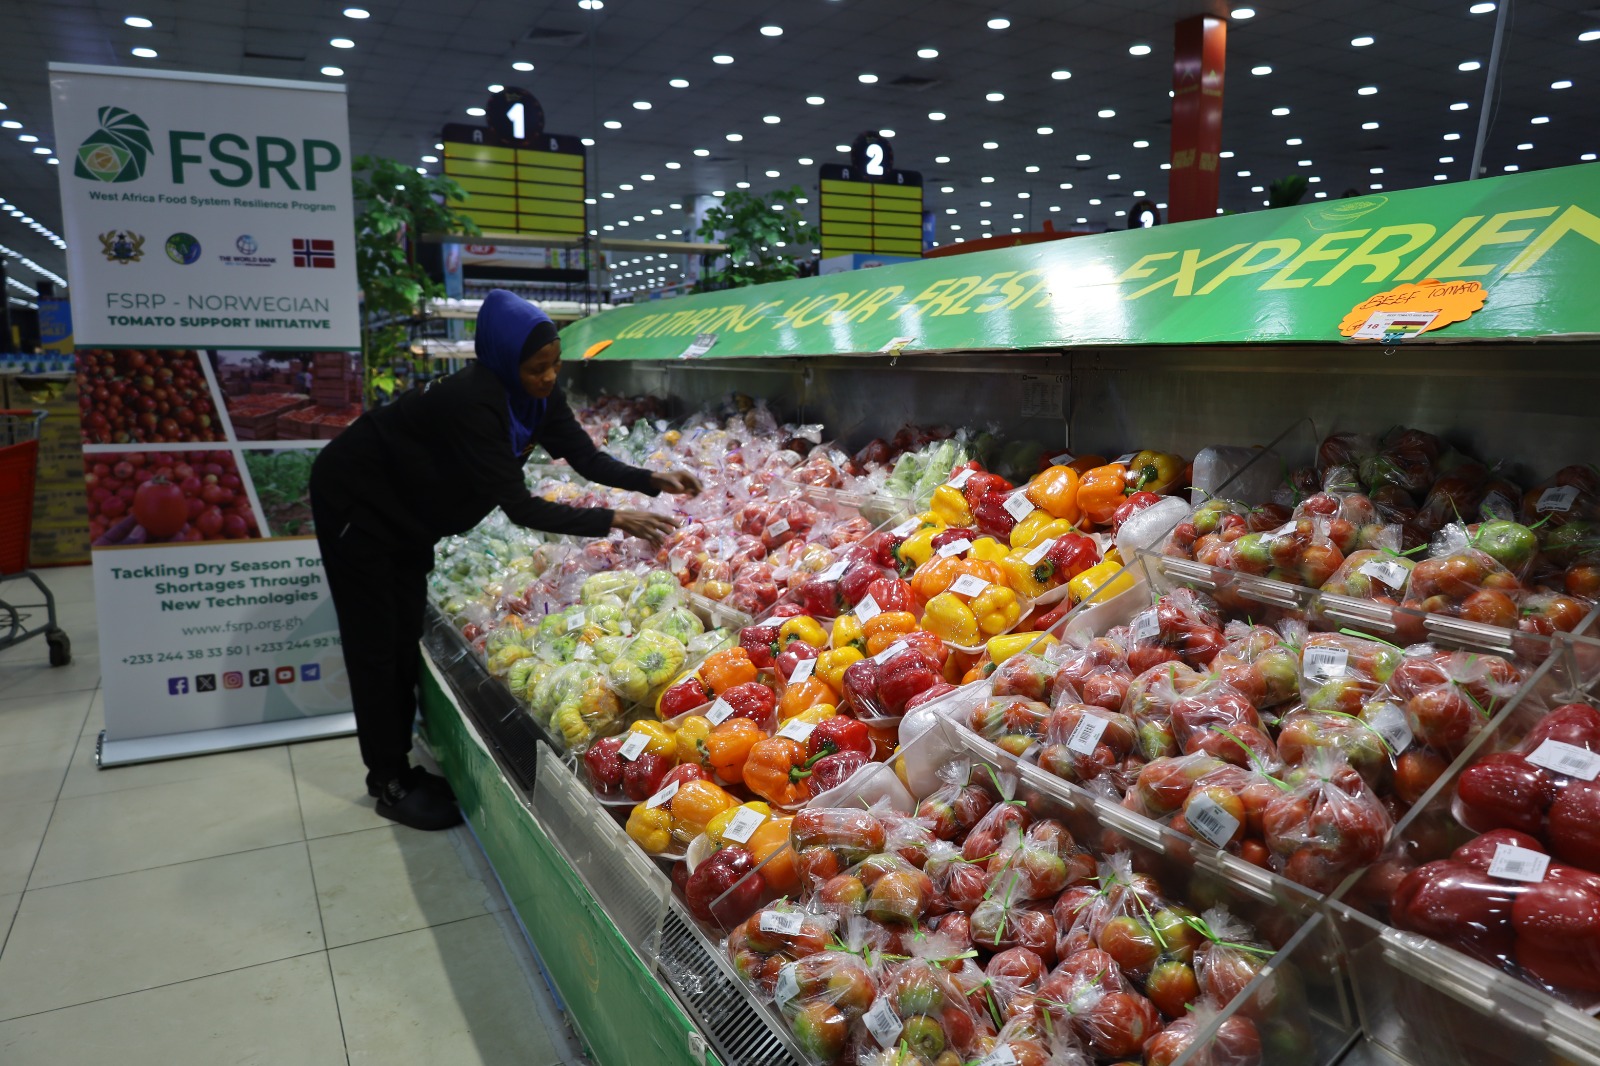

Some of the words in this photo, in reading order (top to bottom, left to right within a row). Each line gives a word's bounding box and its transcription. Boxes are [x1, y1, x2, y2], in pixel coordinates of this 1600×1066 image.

[506, 102, 525, 139] 1
[473, 129, 483, 143] A
[550, 138, 559, 151] B
[168, 130, 341, 191] FSRP
[865, 143, 884, 176] 2
[842, 168, 850, 179] A
[897, 173, 904, 184] B
[89, 190, 118, 201] West
[122, 192, 155, 203] Africa
[158, 194, 187, 204] Food
[190, 195, 230, 207] System
[234, 197, 289, 210] Resilience
[291, 200, 337, 212] Program
[106, 292, 166, 310] FSRP
[188, 294, 330, 313] NORWEGIAN
[1361, 290, 1421, 309] BEEF
[1424, 282, 1479, 299] TOMATO
[771, 285, 905, 330] YOUR
[107, 315, 176, 327] TOMATO
[180, 316, 252, 328] SUPPORT
[255, 318, 331, 329] INITIATIVE
[111, 563, 189, 580] Tackling
[194, 562, 226, 576] Dry
[230, 559, 291, 572] Season
[155, 579, 246, 595] Shortages
[249, 572, 321, 589] Through
[161, 599, 201, 612] New
[204, 590, 319, 609] Technologies
[181, 615, 304, 637] www.fsrp.org.gh
[121, 652, 154, 666] +233
[157, 651, 184, 664] 244
[187, 649, 204, 660] 38
[207, 647, 223, 658] 33
[226, 645, 243, 656] 50
[253, 641, 283, 653] +233
[285, 639, 311, 650] 244
[313, 637, 329, 648] 92
